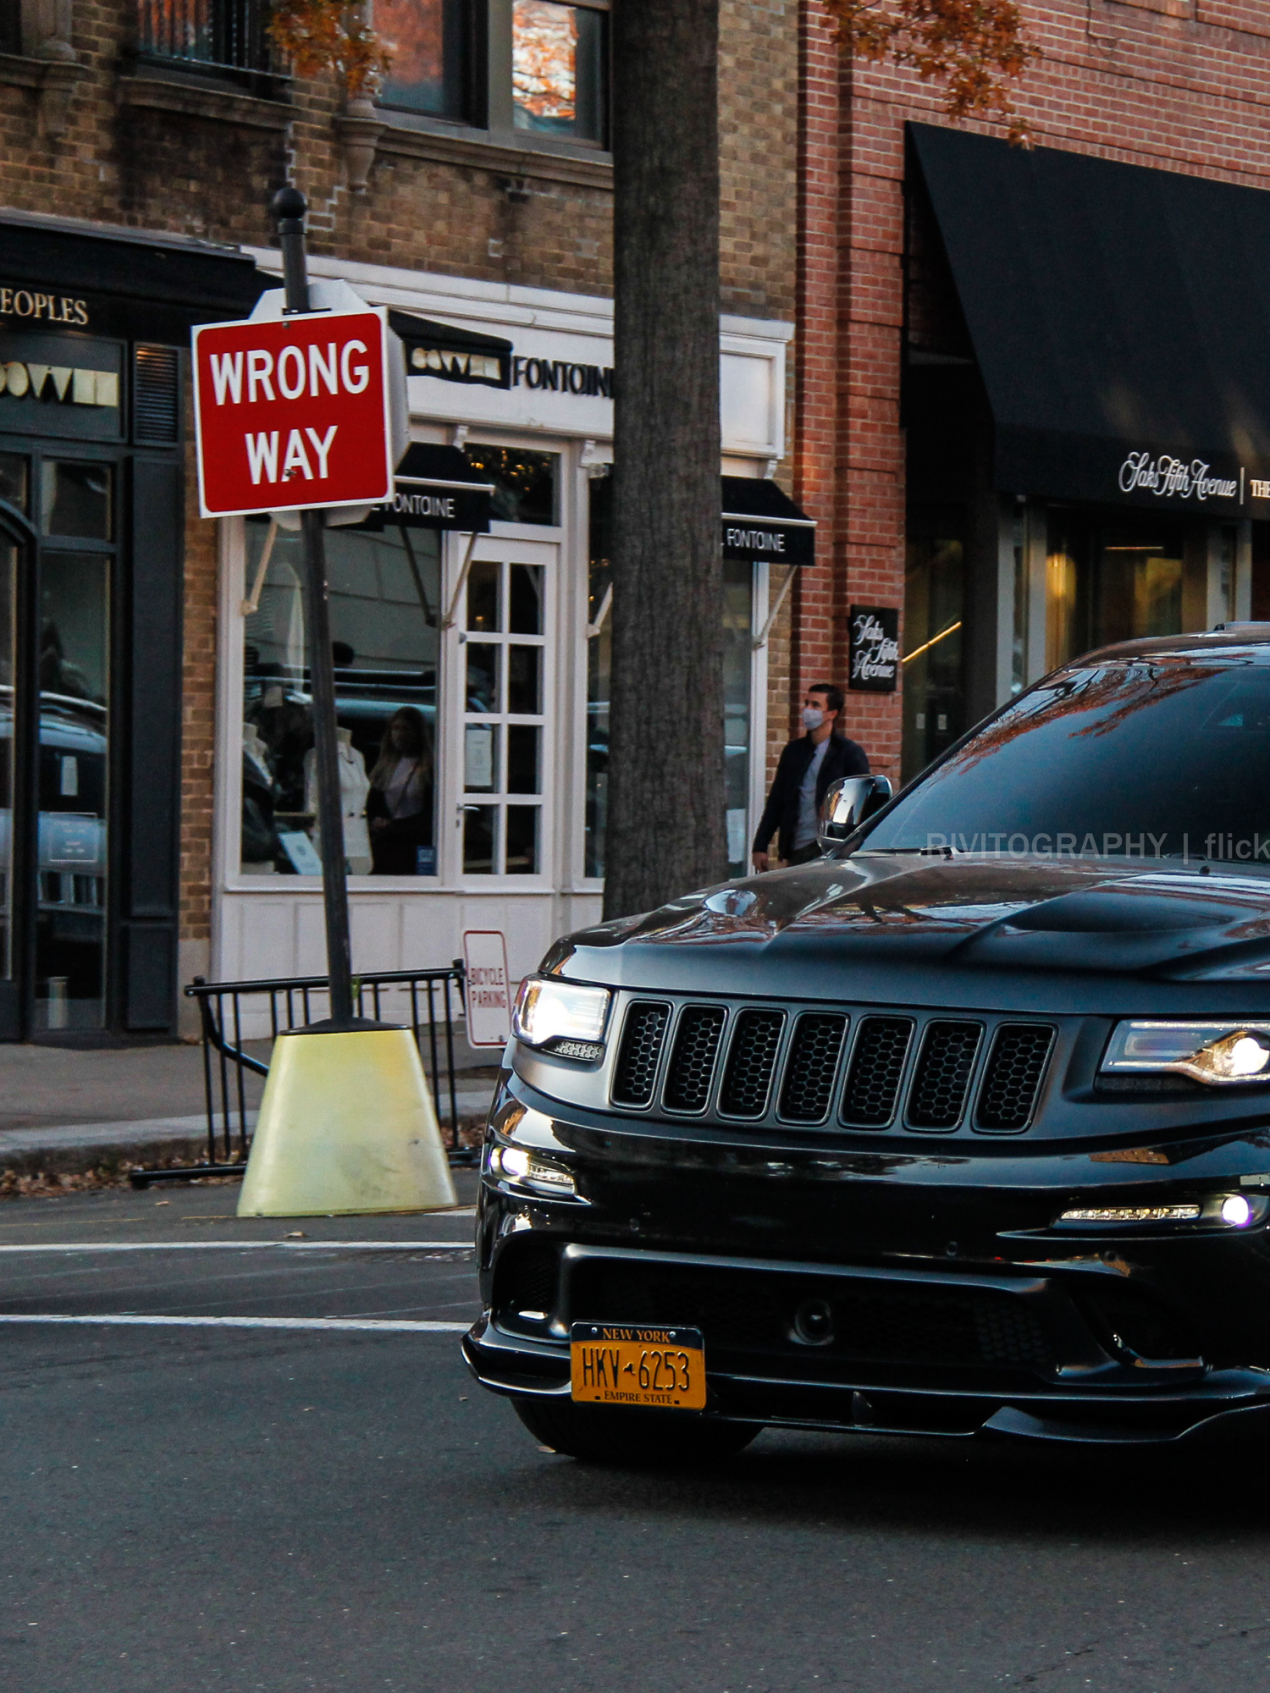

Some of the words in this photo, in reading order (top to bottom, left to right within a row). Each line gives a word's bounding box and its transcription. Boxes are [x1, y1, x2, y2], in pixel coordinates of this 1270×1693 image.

[0, 287, 89, 325] EOPLES
[209, 339, 370, 406] WRONG
[245, 425, 339, 485] WAY
[1118, 451, 1159, 493] Saks
[1153, 455, 1189, 497] Fifth
[1179, 459, 1237, 500] Avenue
[470, 967, 505, 986] BICYCLE
[472, 990, 507, 1008] PARKING
[602, 1327, 633, 1341] NEW
[635, 1329, 671, 1344] YORK
[581, 1346, 620, 1388] HKV
[638, 1350, 690, 1392] 6253
[604, 1390, 640, 1402] EMPIRE
[643, 1393, 673, 1405] STATE
